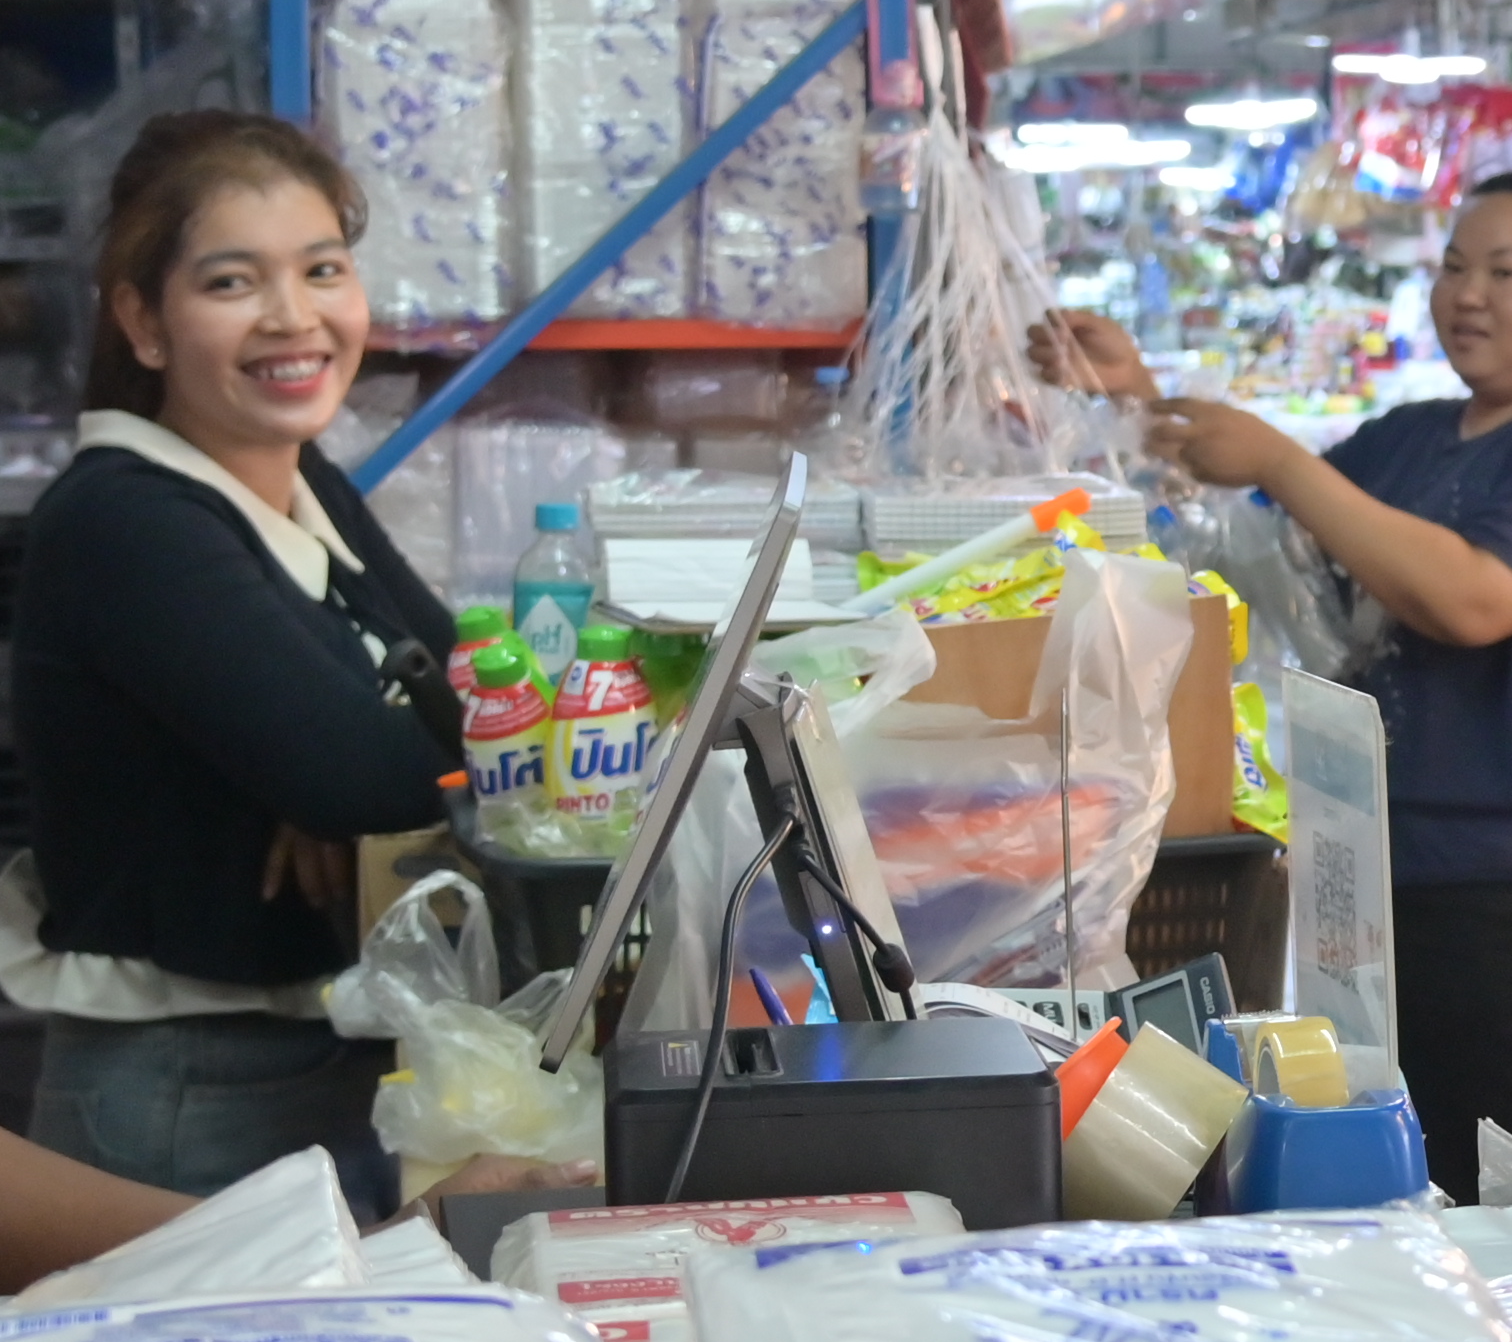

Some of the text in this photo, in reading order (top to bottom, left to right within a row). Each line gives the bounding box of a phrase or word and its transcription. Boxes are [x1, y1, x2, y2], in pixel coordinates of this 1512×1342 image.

[587, 669, 614, 712] 7
[555, 793, 610, 812] PINTO
[1199, 976, 1216, 1015] CASIO
